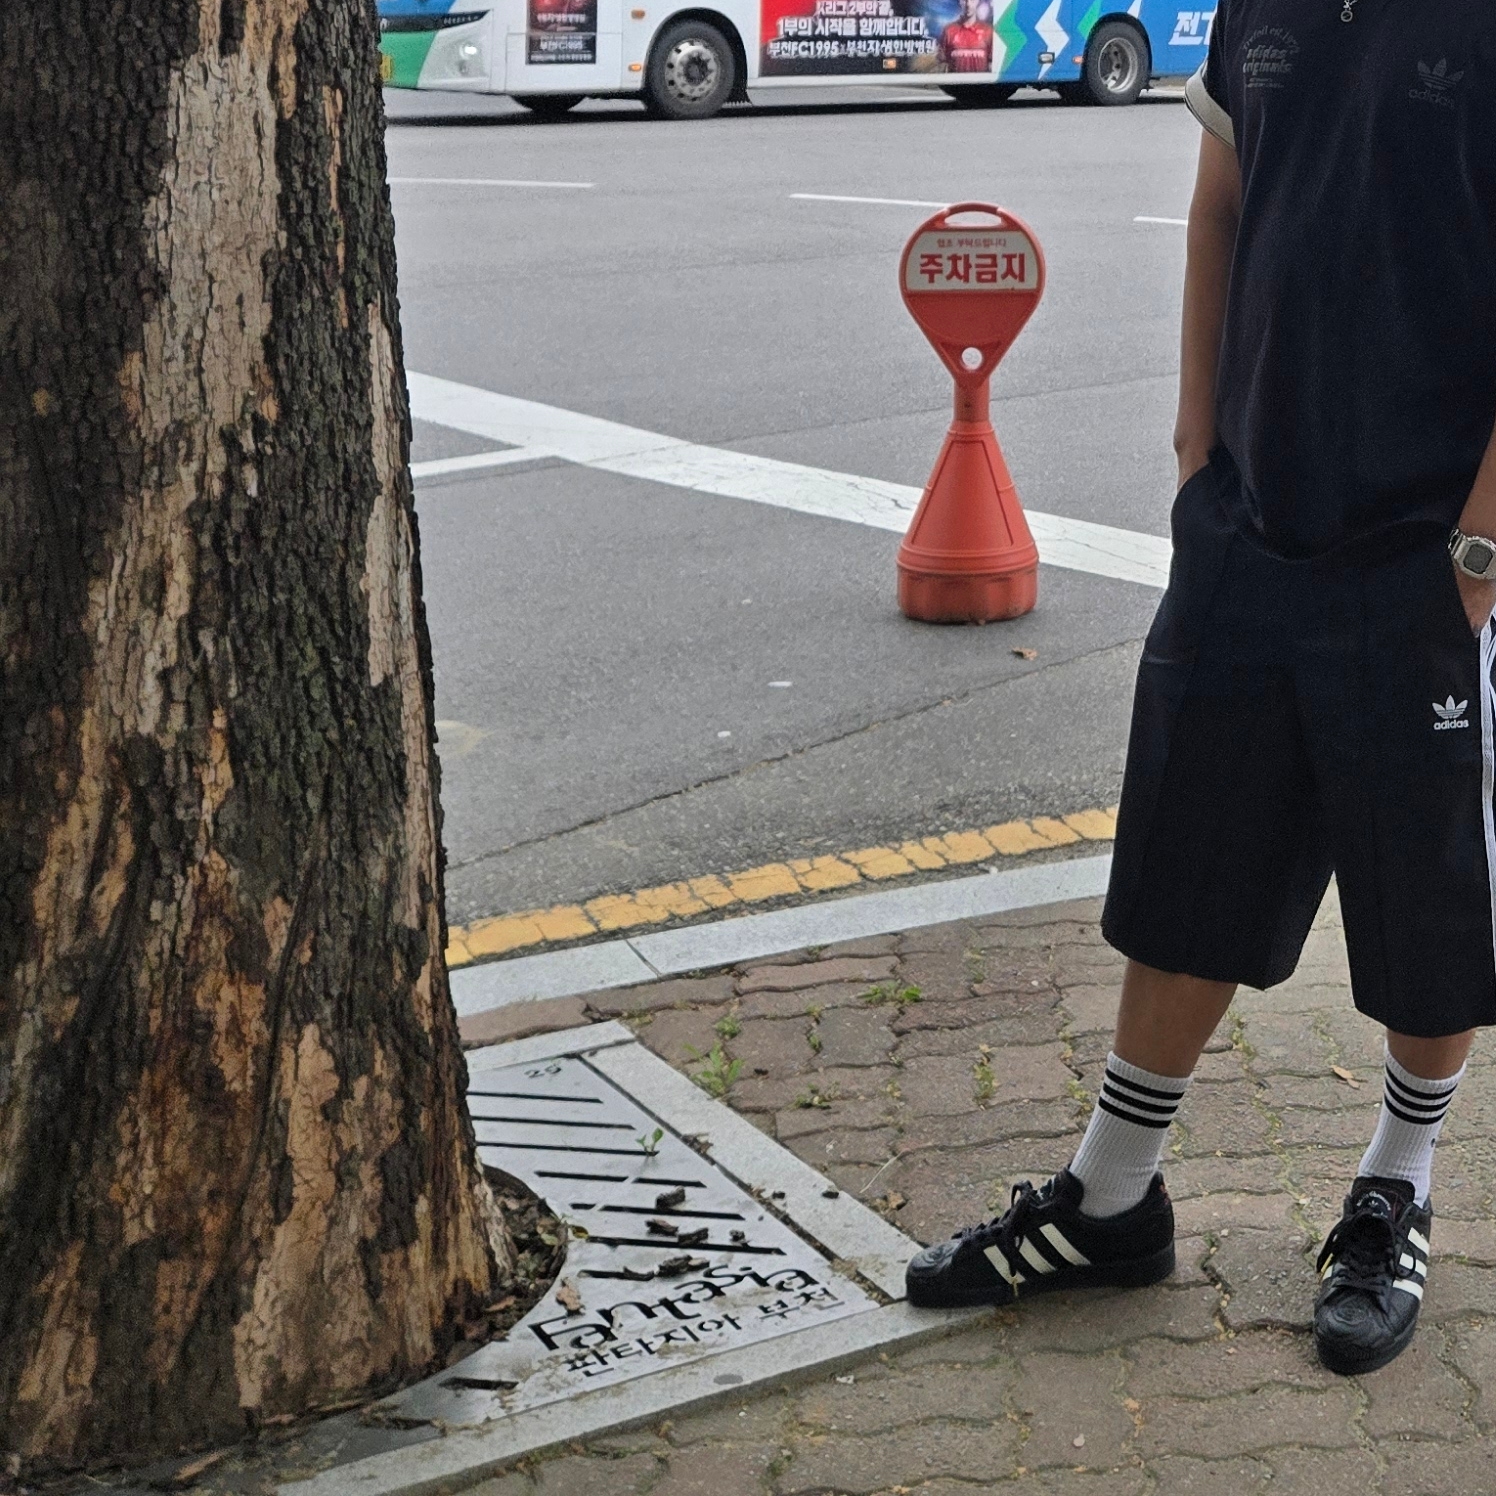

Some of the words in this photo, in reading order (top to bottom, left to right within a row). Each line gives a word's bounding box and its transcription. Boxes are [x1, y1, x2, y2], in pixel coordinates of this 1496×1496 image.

[920, 253, 1025, 283] 주차금지
[1433, 719, 1469, 731] adidas
[529, 1264, 821, 1351] Fantasia
[758, 1287, 846, 1320] 부천
